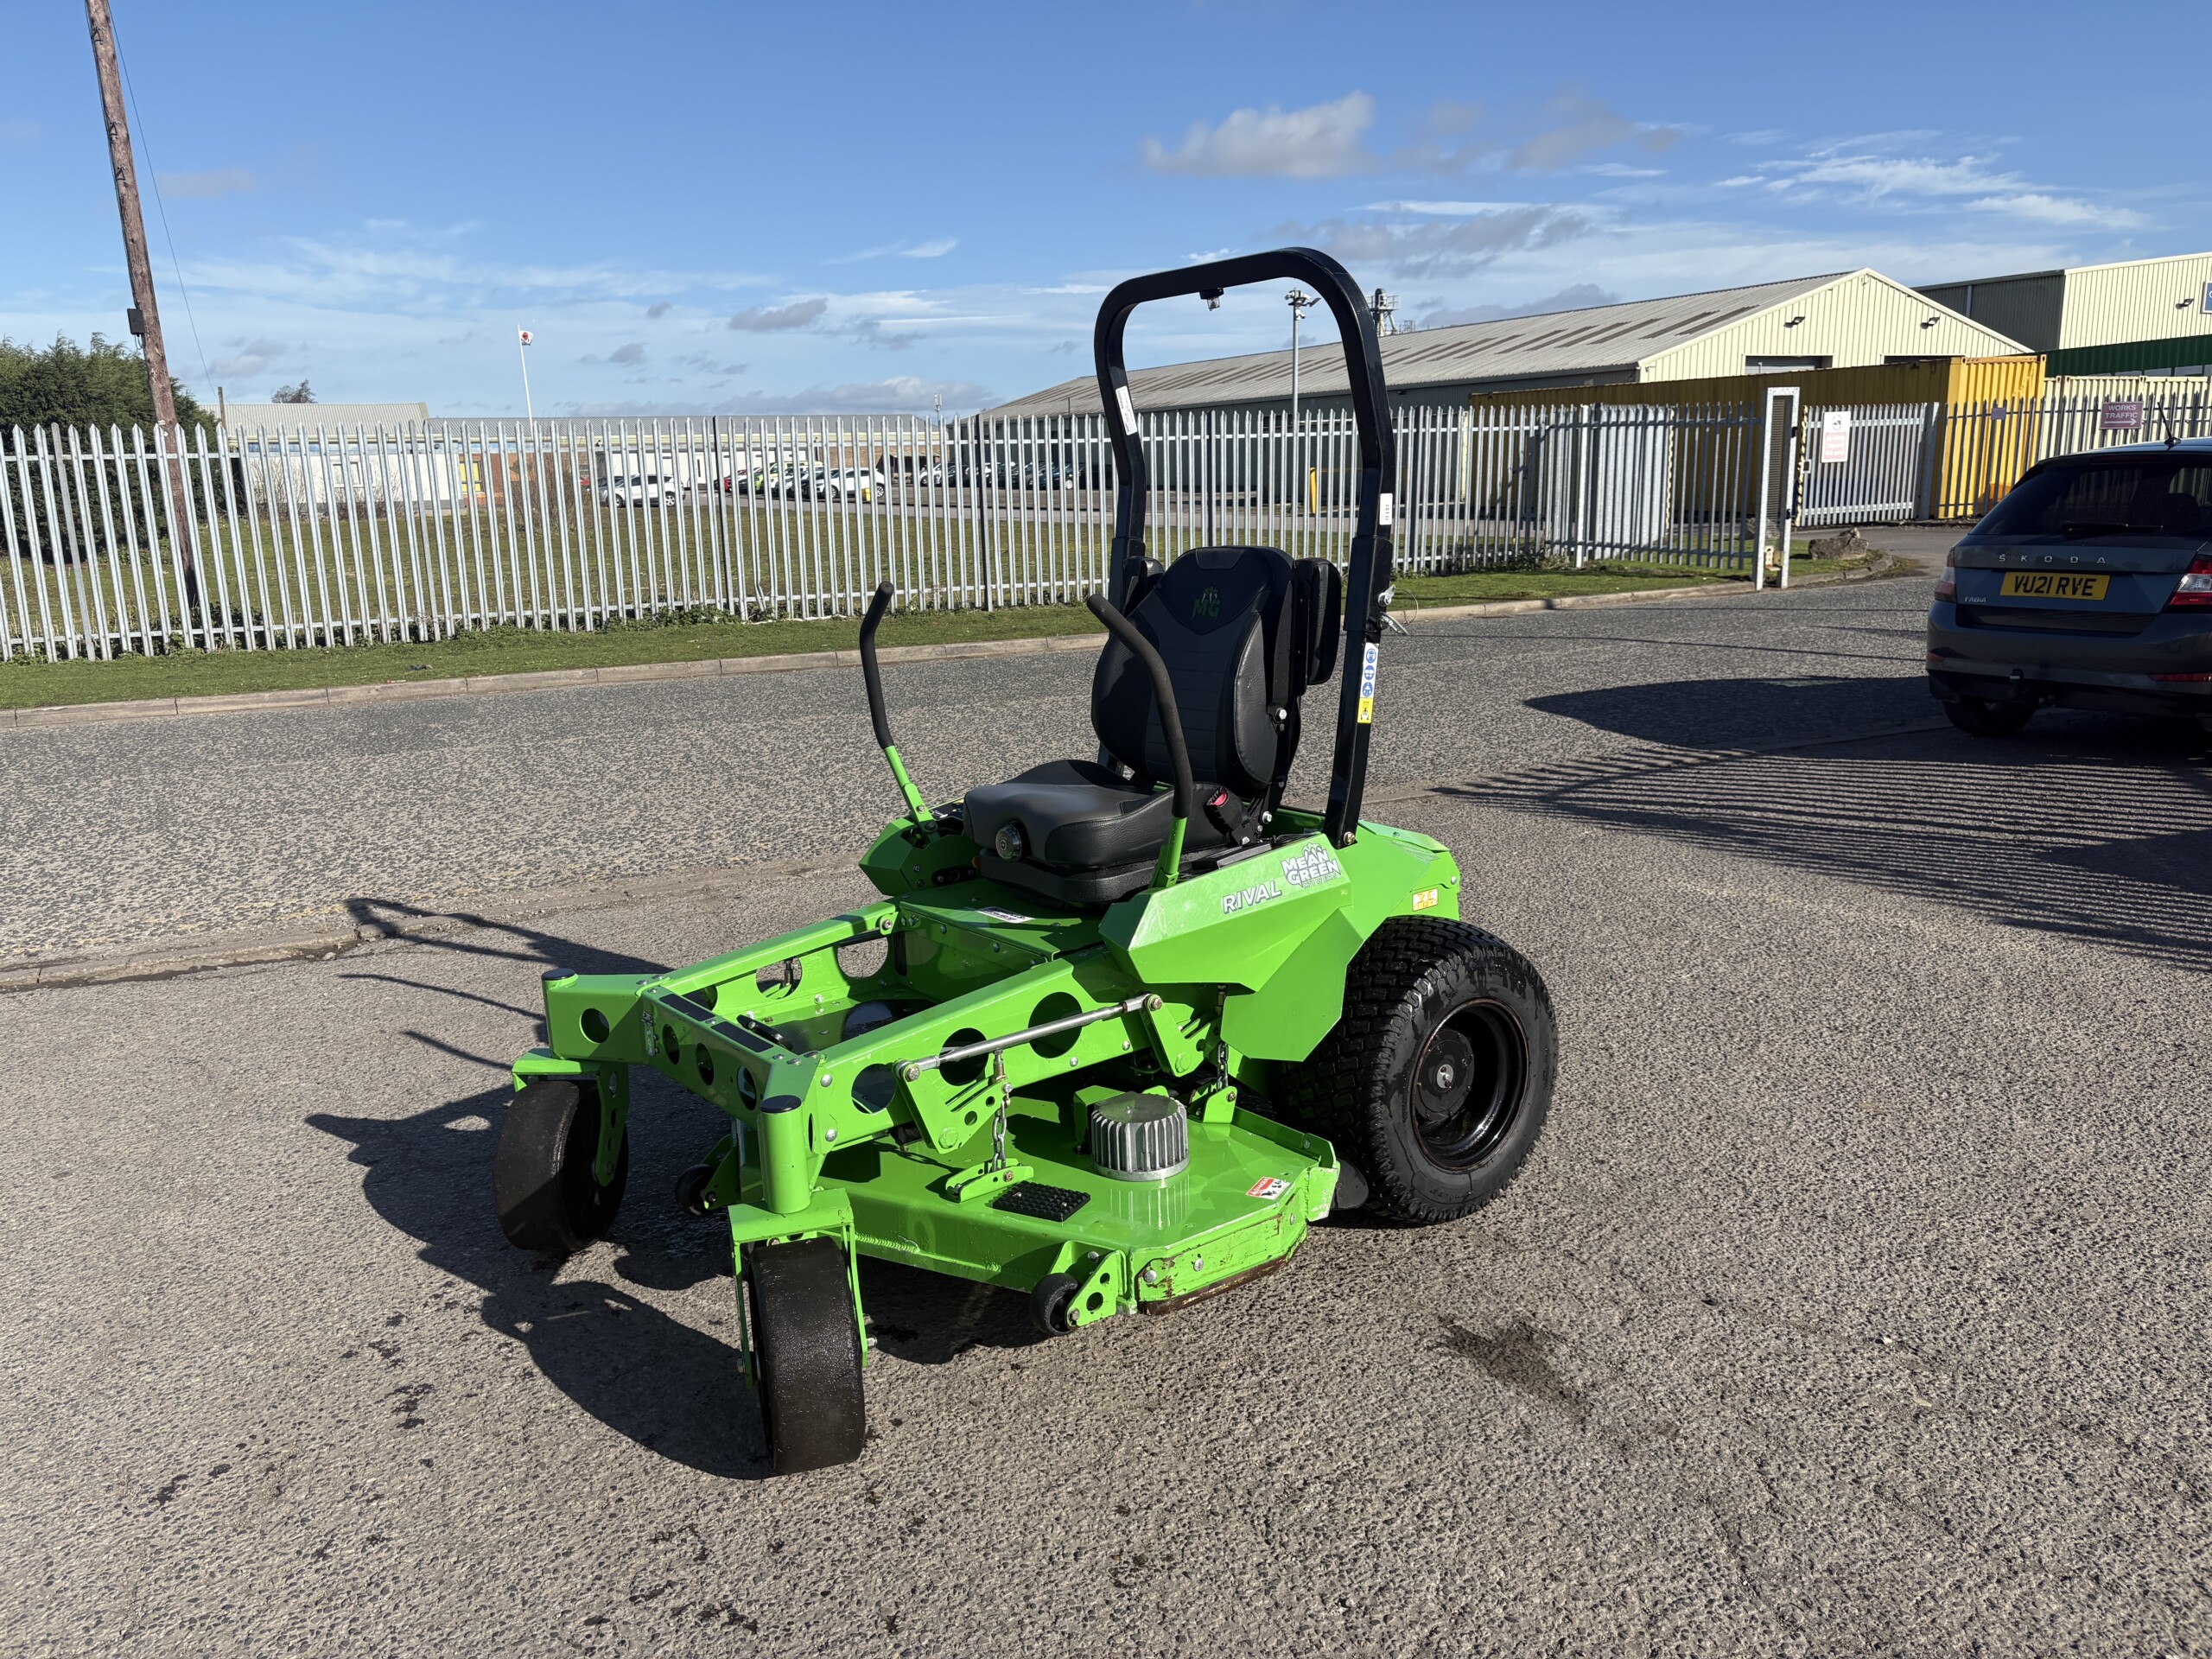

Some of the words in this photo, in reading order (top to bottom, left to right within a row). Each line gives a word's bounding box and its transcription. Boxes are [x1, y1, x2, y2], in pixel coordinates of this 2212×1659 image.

[2014, 575, 2053, 594] VU21
[2056, 576, 2097, 596] RVE
[1191, 598, 1221, 620] MG
[1281, 848, 1330, 880] MEAN
[1287, 858, 1341, 888] GREEN
[1222, 880, 1283, 914] RIVAL
